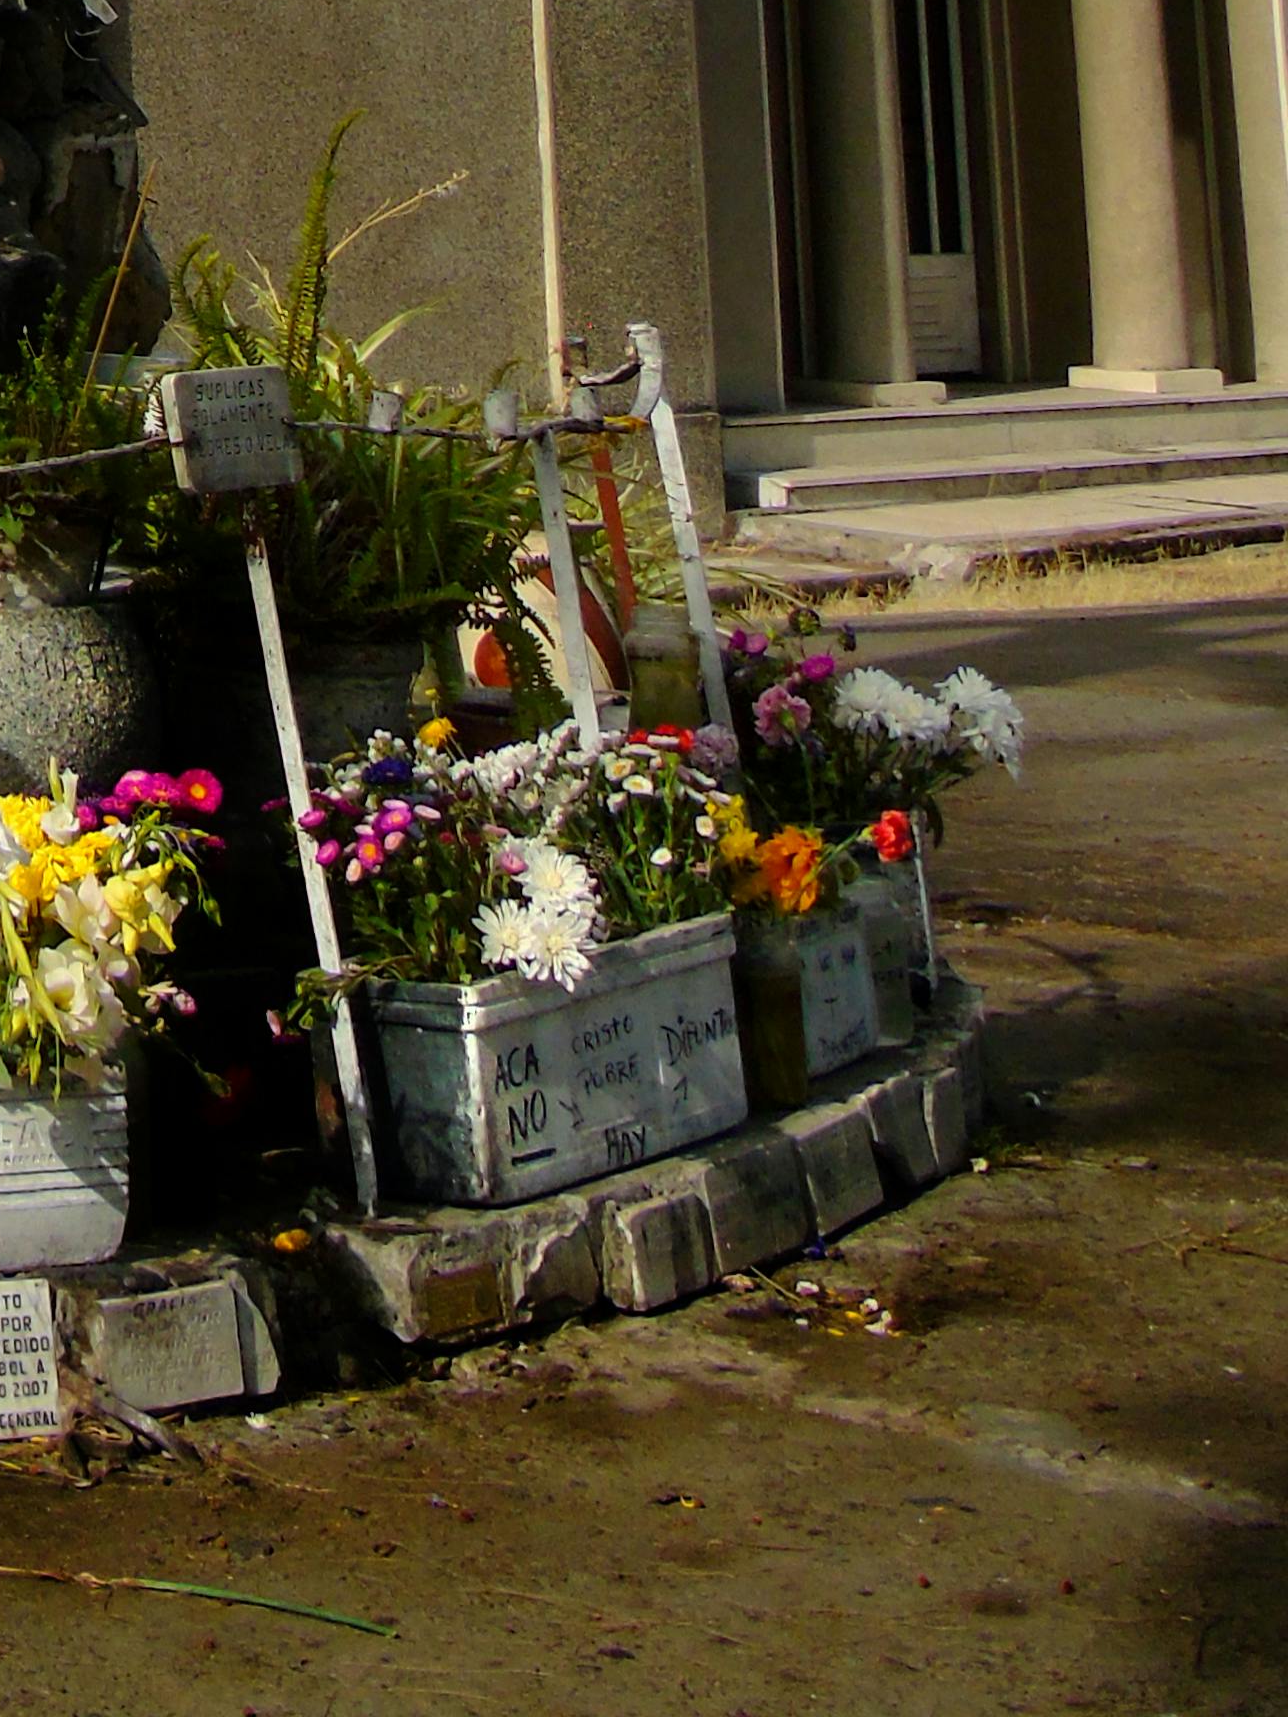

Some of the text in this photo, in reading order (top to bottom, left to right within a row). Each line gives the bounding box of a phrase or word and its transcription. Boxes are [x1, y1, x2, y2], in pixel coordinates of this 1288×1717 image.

[195, 378, 264, 401] SUPLICAS
[192, 402, 273, 427] SOLAMENTE
[494, 1042, 540, 1096] ACA
[577, 1053, 639, 1096] POBRE
[507, 1088, 547, 1147] NO
[604, 1125, 647, 1166] HAY
[1, 1316, 32, 1333] POR
[13, 1380, 49, 1398] 2007
[0, 1410, 58, 1429] GENERAL
